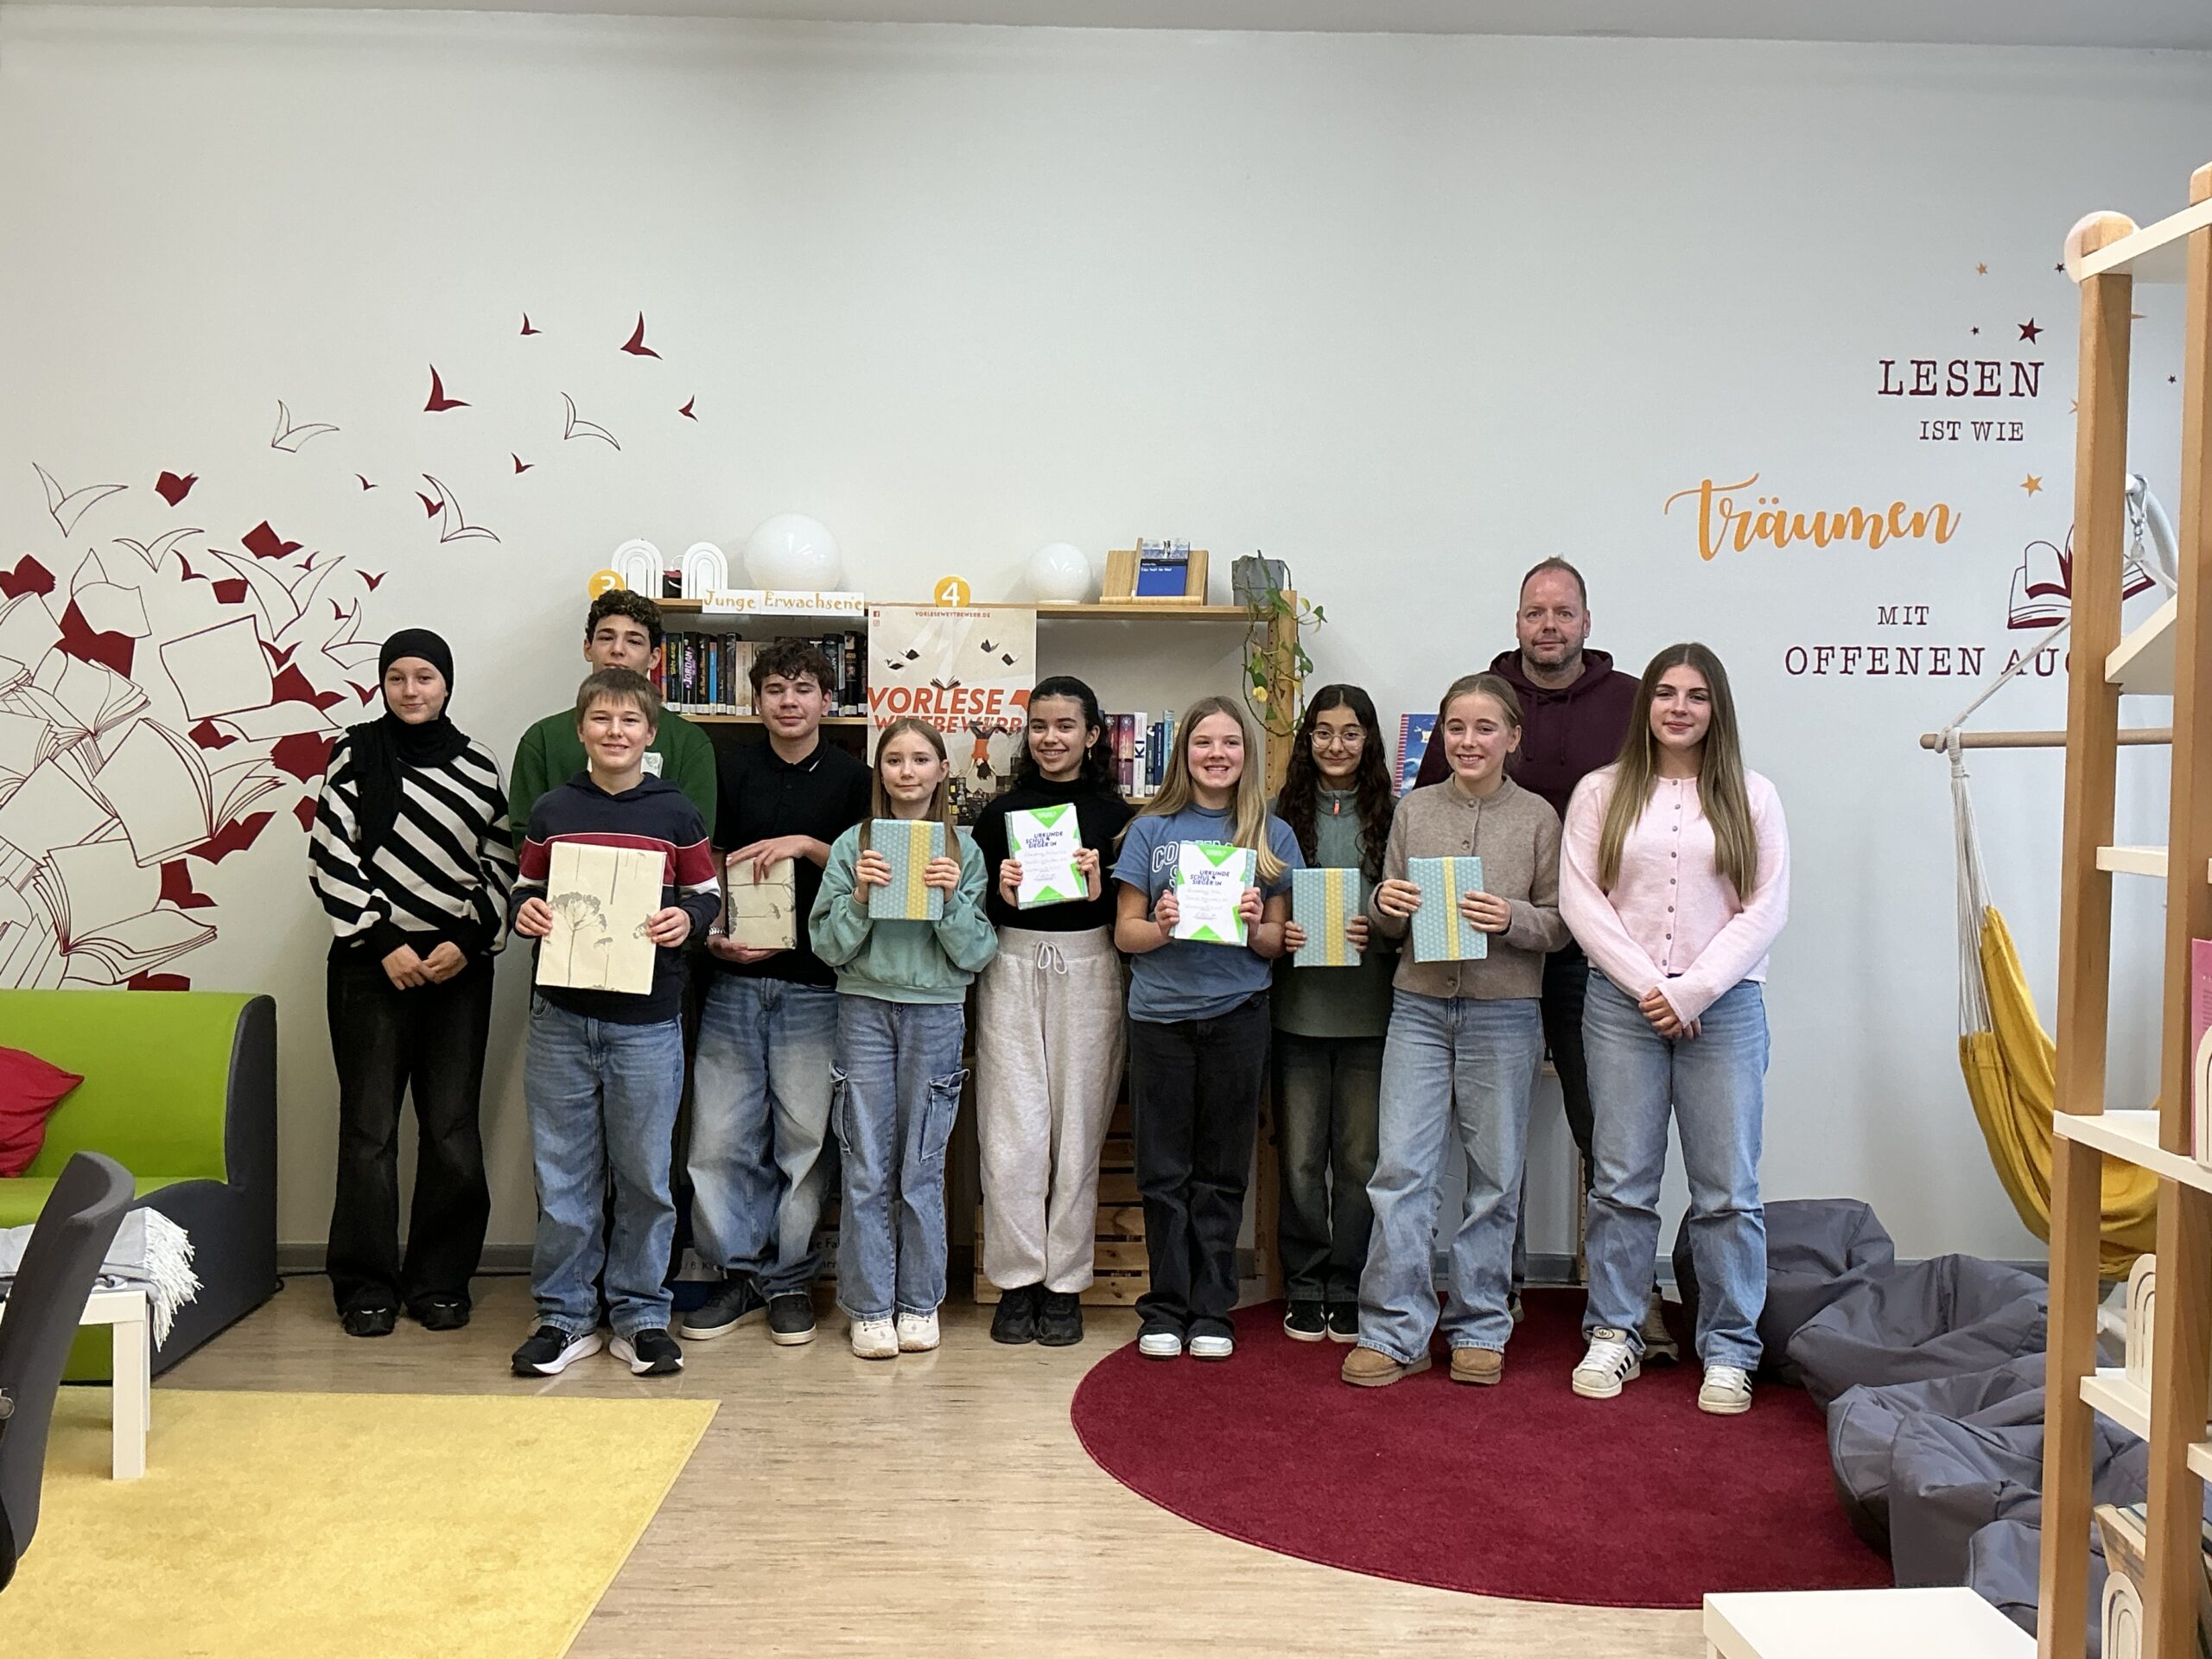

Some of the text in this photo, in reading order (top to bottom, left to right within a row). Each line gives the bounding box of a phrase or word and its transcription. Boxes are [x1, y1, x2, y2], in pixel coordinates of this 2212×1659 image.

[1878, 359, 2044, 397] LESEN
[1919, 420, 2024, 442] IST WIE
[1664, 473, 1961, 562] träumen
[703, 589, 863, 612] Junge Erwachsene
[941, 582, 960, 607] 4
[1878, 606, 1929, 626] MIT
[1785, 646, 2070, 677] OFFENEN AU
[868, 687, 1004, 715] VORLESE
[1135, 741, 1145, 759] KI
